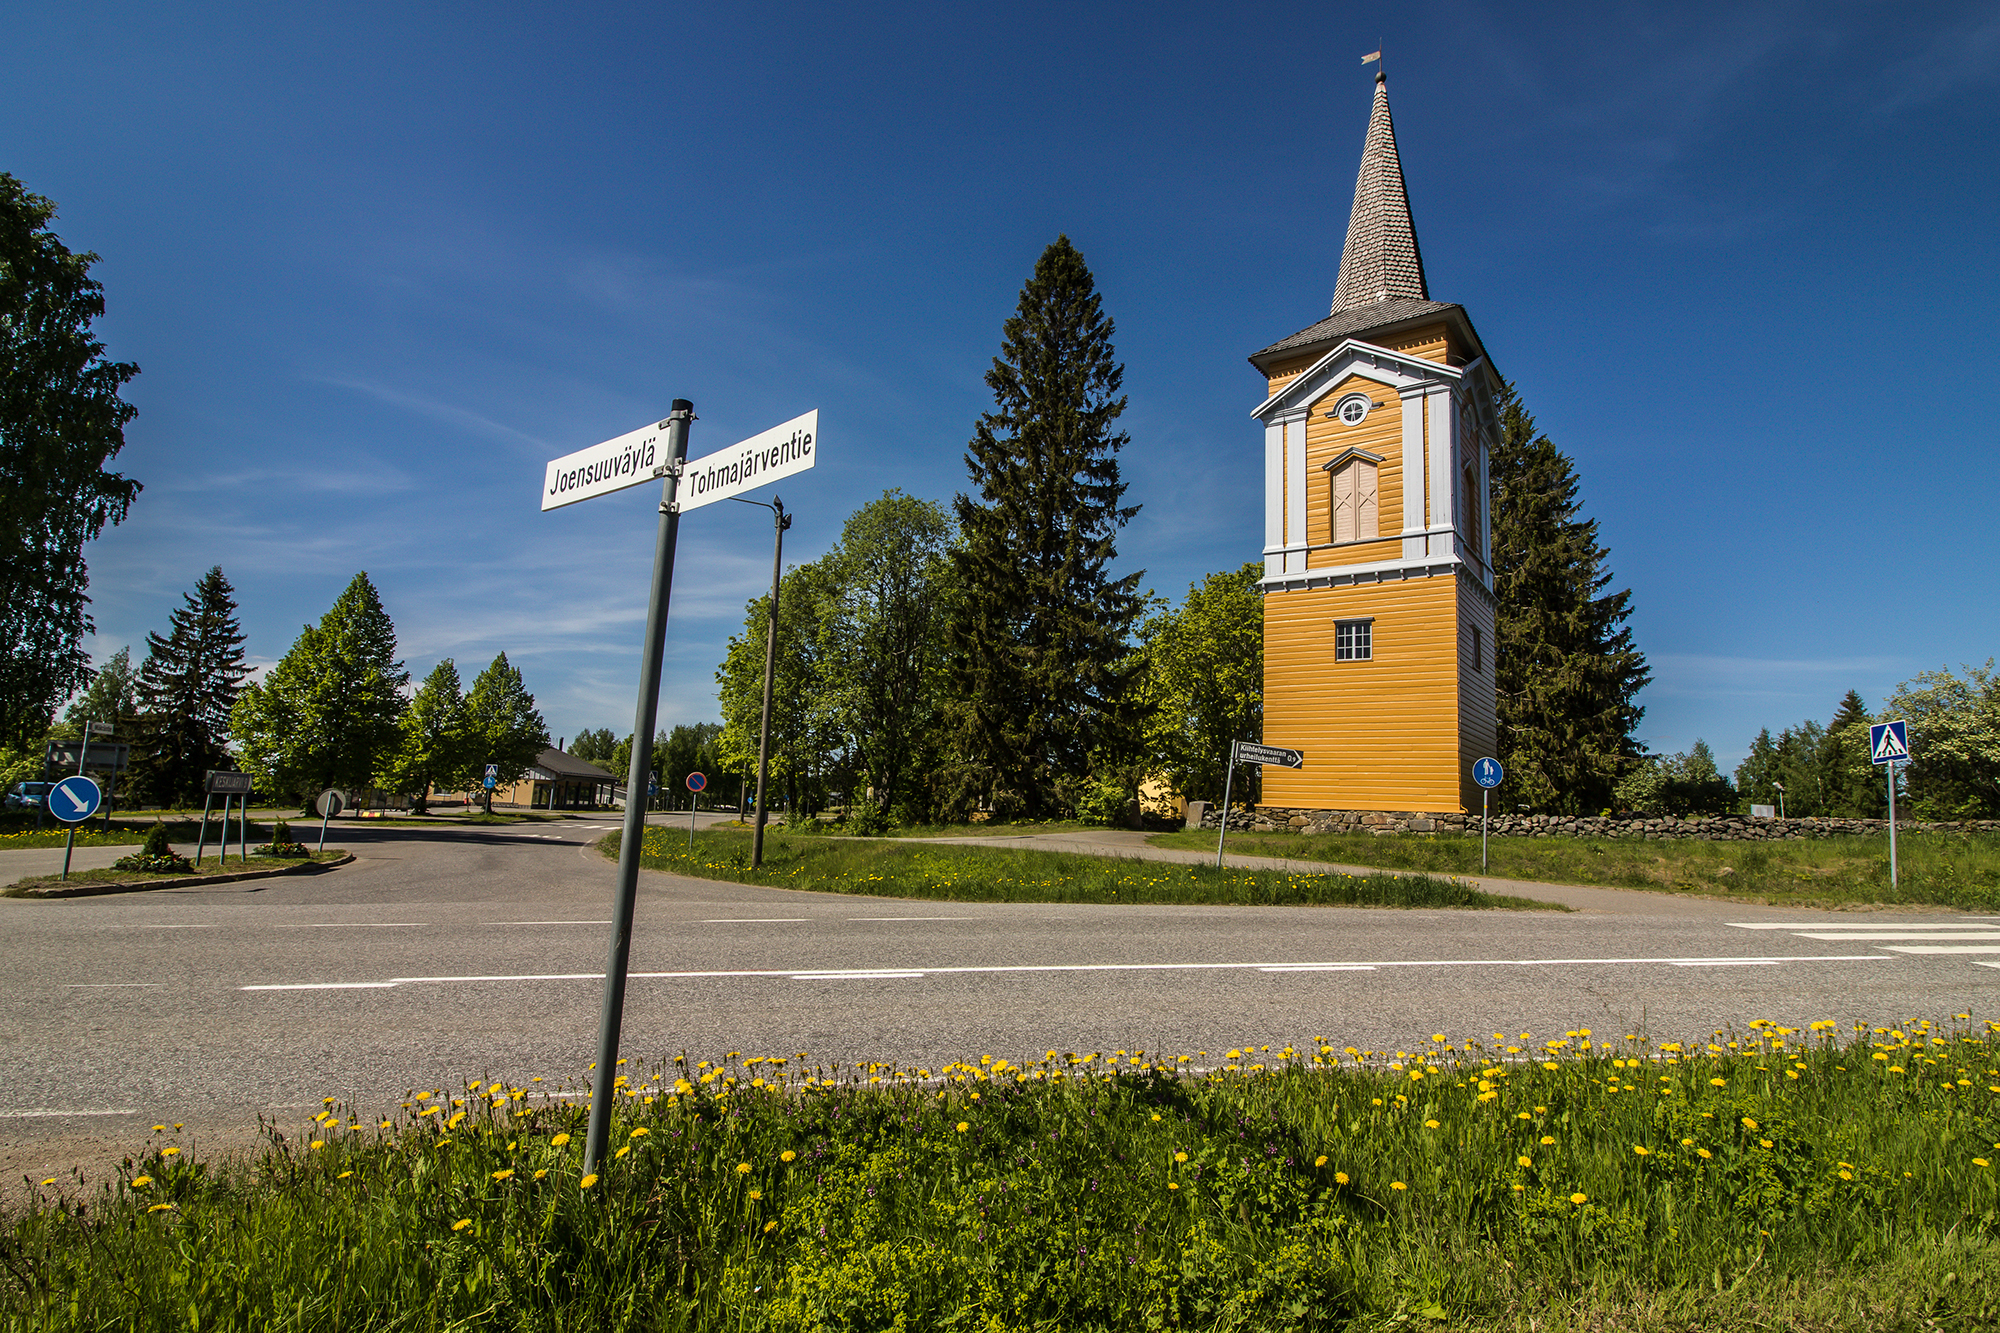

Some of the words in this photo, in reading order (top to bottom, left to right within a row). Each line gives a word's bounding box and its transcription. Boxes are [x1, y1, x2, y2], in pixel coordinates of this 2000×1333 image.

[550, 436, 656, 495] Joensuuväylä
[690, 429, 812, 497] Tohmajärventie
[1240, 744, 1287, 757] Kiihtelysvaaran
[1240, 753, 1281, 764] urheilukenttä
